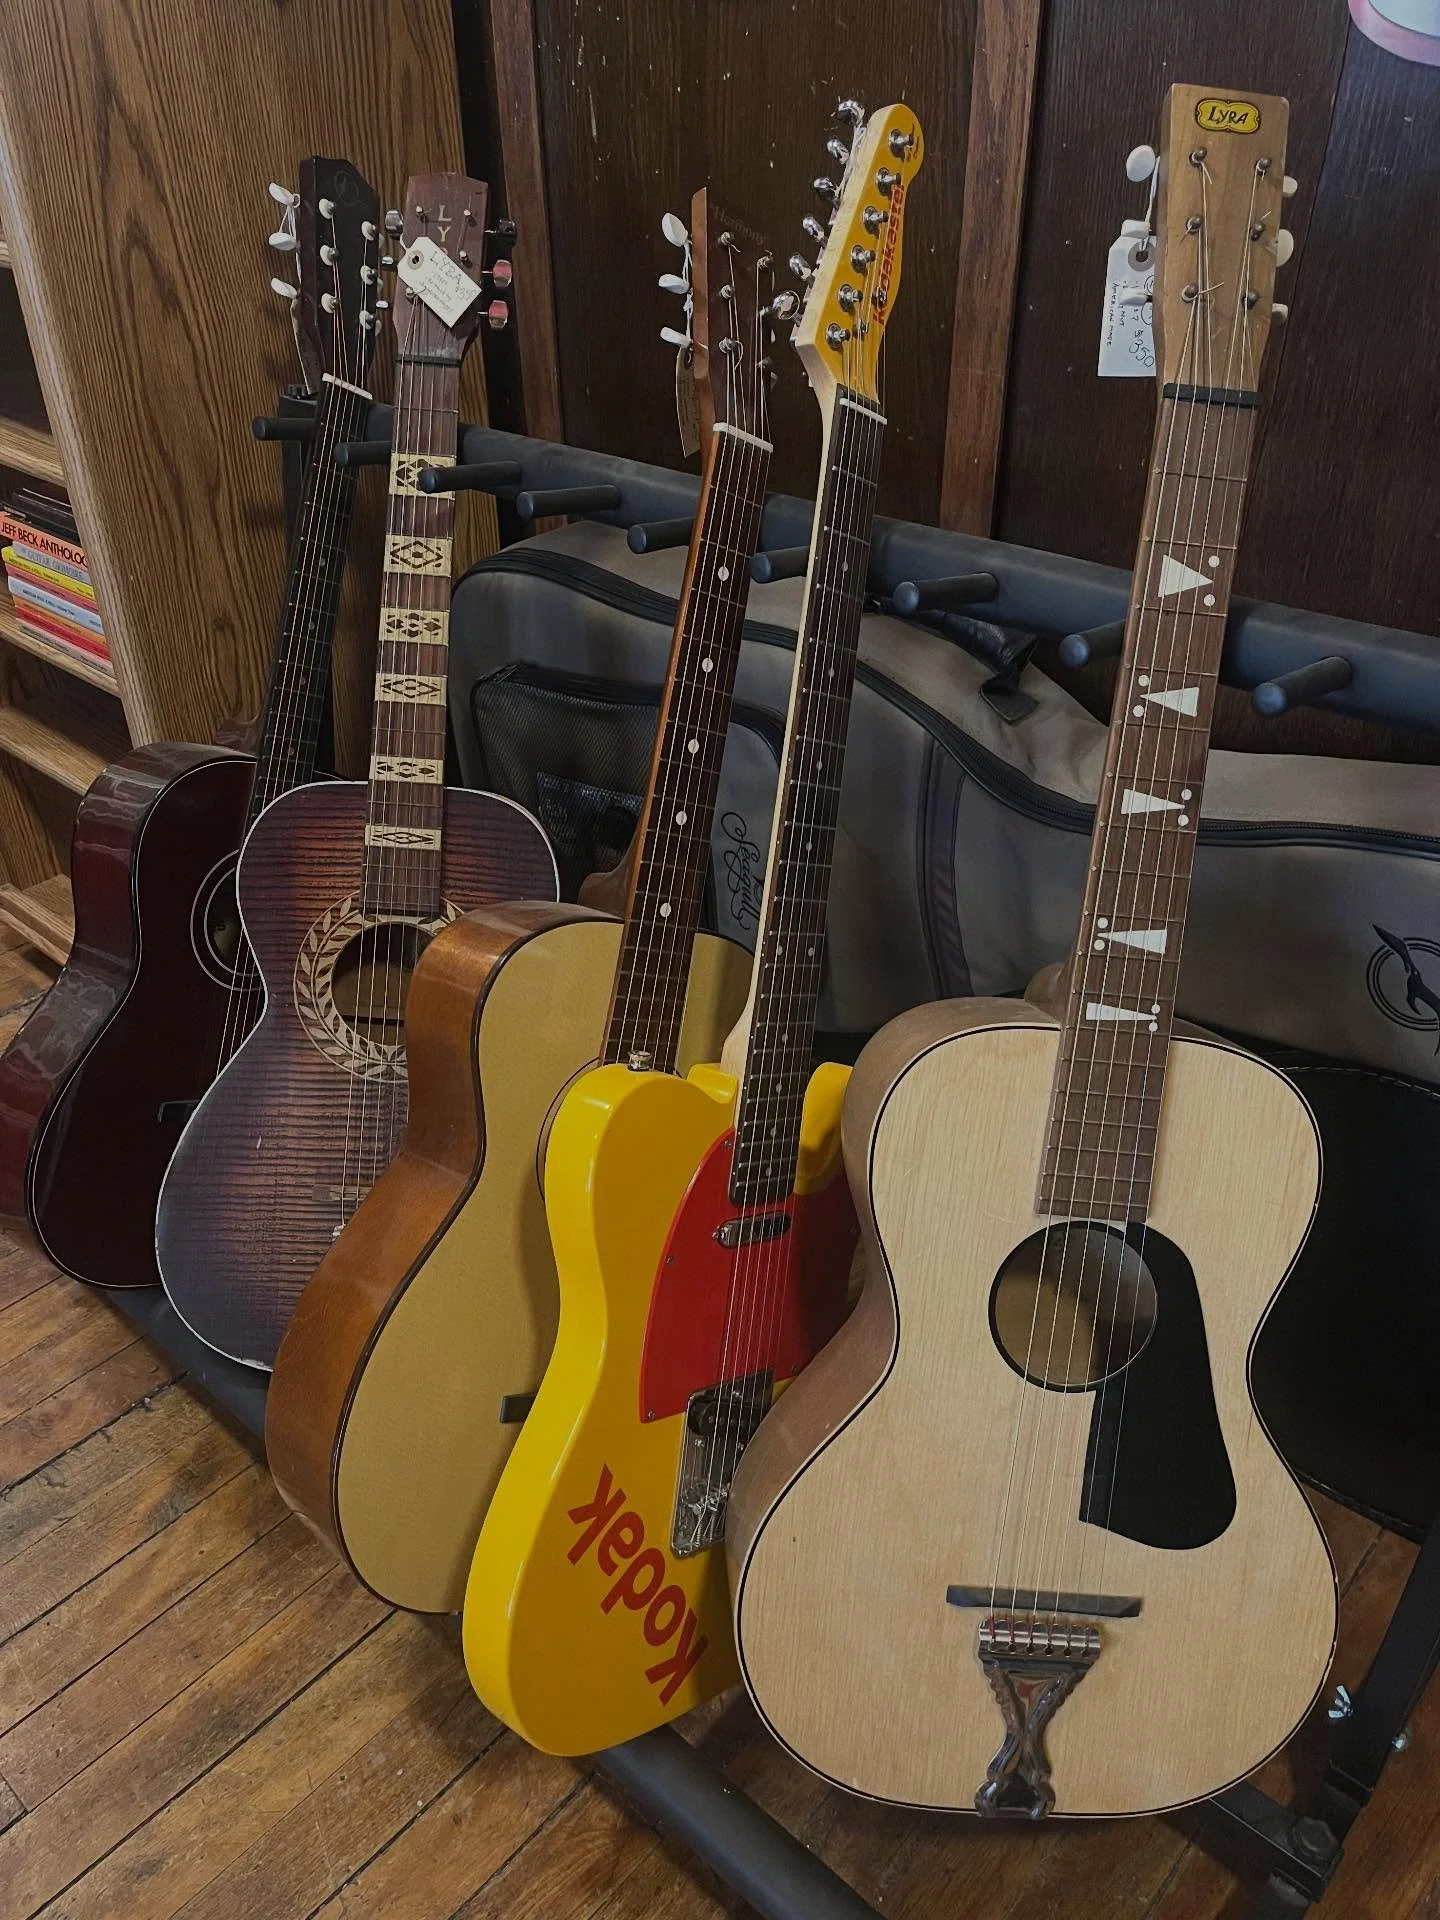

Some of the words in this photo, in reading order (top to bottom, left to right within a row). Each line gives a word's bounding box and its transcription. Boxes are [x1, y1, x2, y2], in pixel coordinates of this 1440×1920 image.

[1208, 106, 1249, 125] LYRA
[1, 521, 17, 537] JEFF
[18, 528, 39, 547] BECK
[567, 1463, 709, 1707] Kodak
